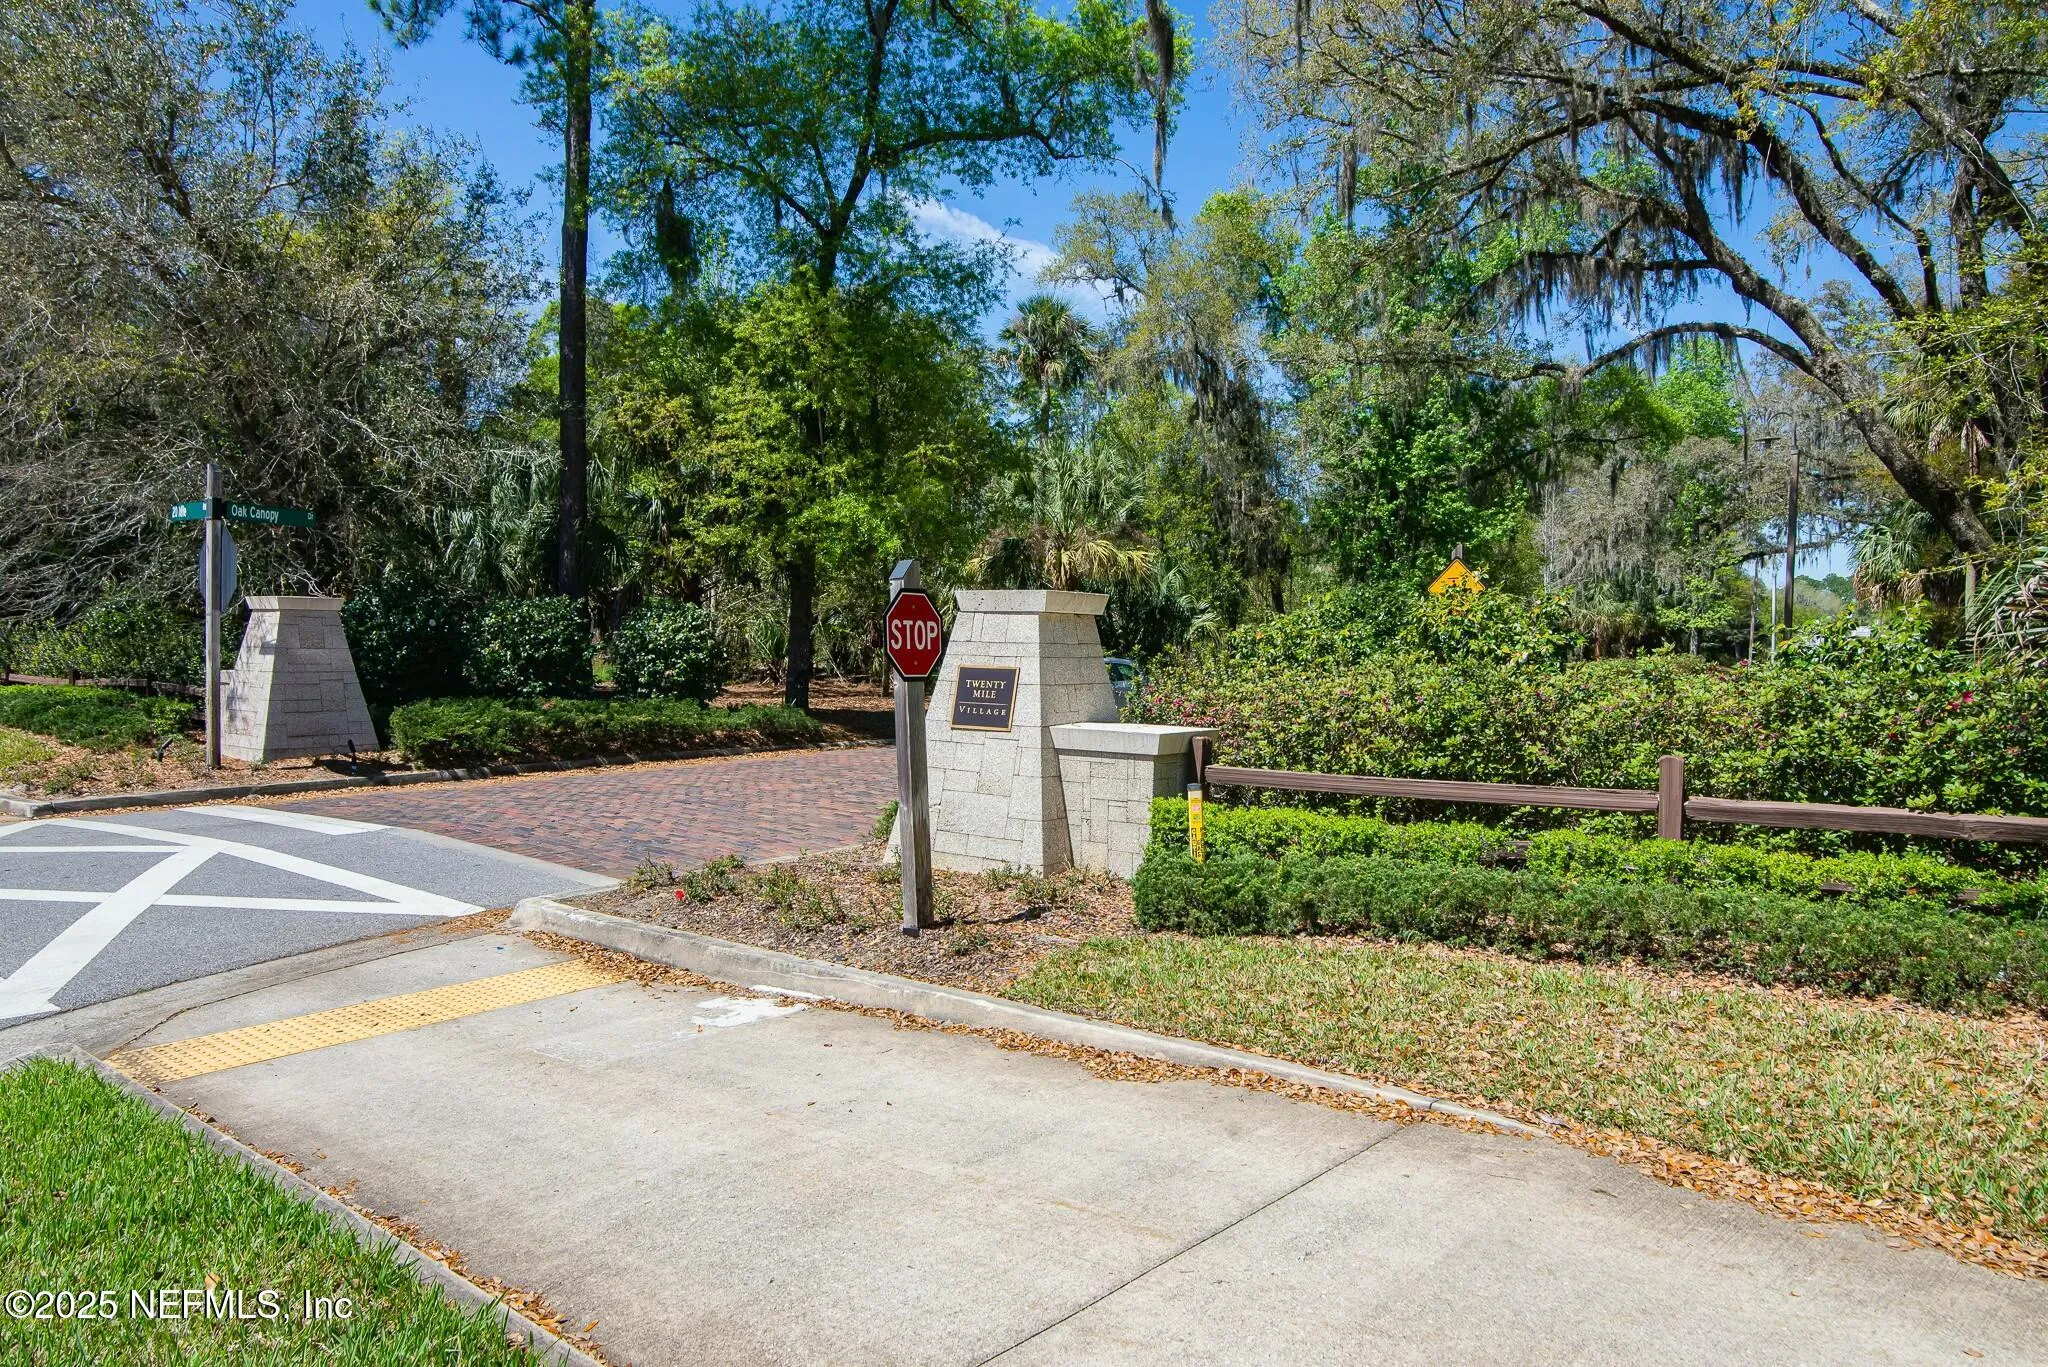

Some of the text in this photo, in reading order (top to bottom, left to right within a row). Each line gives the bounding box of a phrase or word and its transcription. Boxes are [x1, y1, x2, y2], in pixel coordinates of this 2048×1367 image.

[231, 504, 248, 518] Oak
[250, 506, 279, 524] Canopy
[890, 619, 938, 650] STOP
[965, 679, 1007, 689] TWENTY
[972, 689, 997, 699] MILE
[959, 705, 1007, 716] VILLAGE
